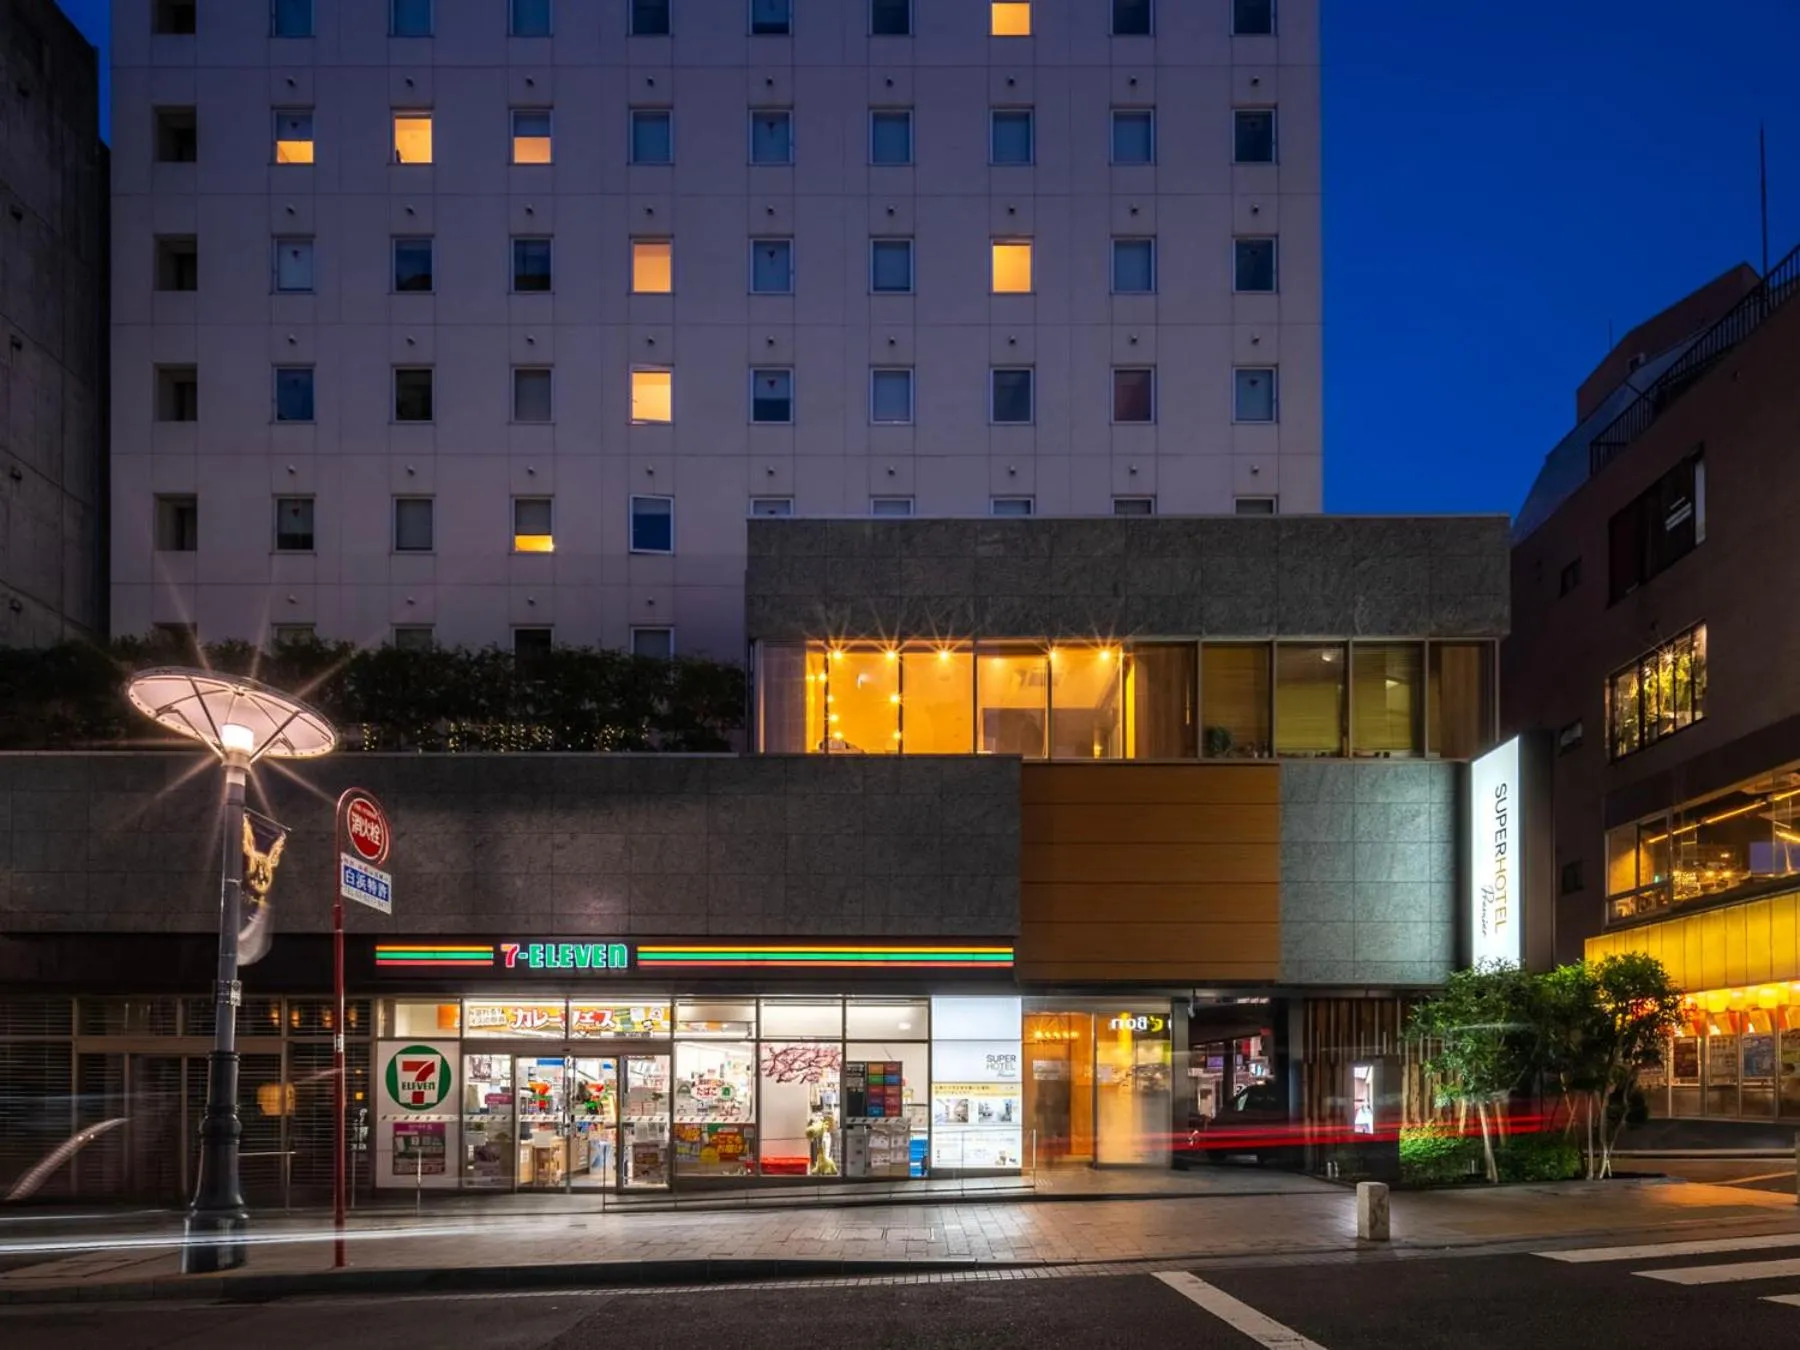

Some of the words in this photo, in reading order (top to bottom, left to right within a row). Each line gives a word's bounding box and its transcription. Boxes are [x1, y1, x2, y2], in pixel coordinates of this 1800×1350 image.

[351, 811, 381, 846] 消火栓
[511, 1007, 617, 1028] カレーフェス
[986, 1054, 1016, 1062] SUPER
[986, 1062, 1015, 1070] HOTEL
[402, 1060, 435, 1104] 7
[696, 1086, 717, 1096] たばこ
